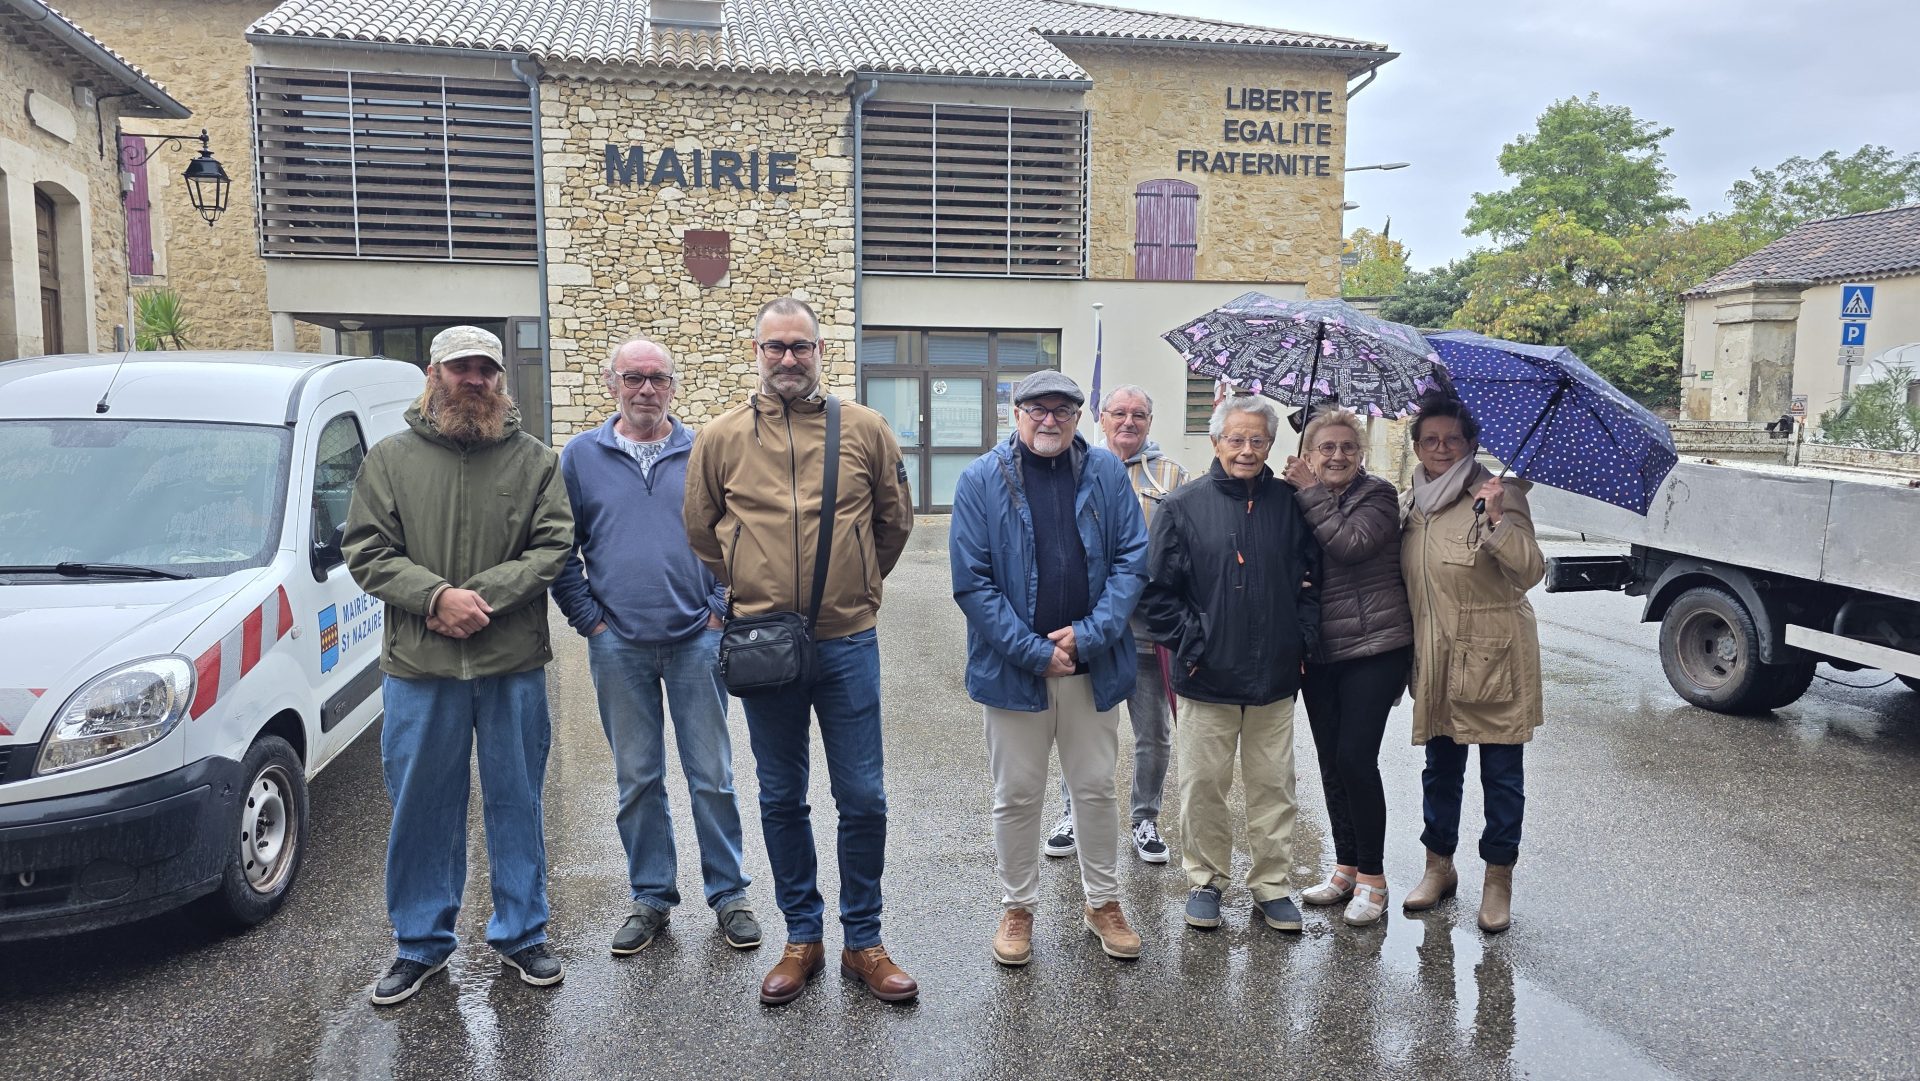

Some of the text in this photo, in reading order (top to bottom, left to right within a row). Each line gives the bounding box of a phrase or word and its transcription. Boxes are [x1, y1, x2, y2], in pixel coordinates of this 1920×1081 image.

[1226, 87, 1333, 113] LIBERTE
[1224, 119, 1332, 145] EGALITE
[605, 144, 798, 192] MAIRIE
[1177, 150, 1331, 176] FRATERNITE
[1848, 327, 1860, 342] P
[342, 593, 368, 624] MAIRIE
[352, 610, 381, 645] NAZAIRE
